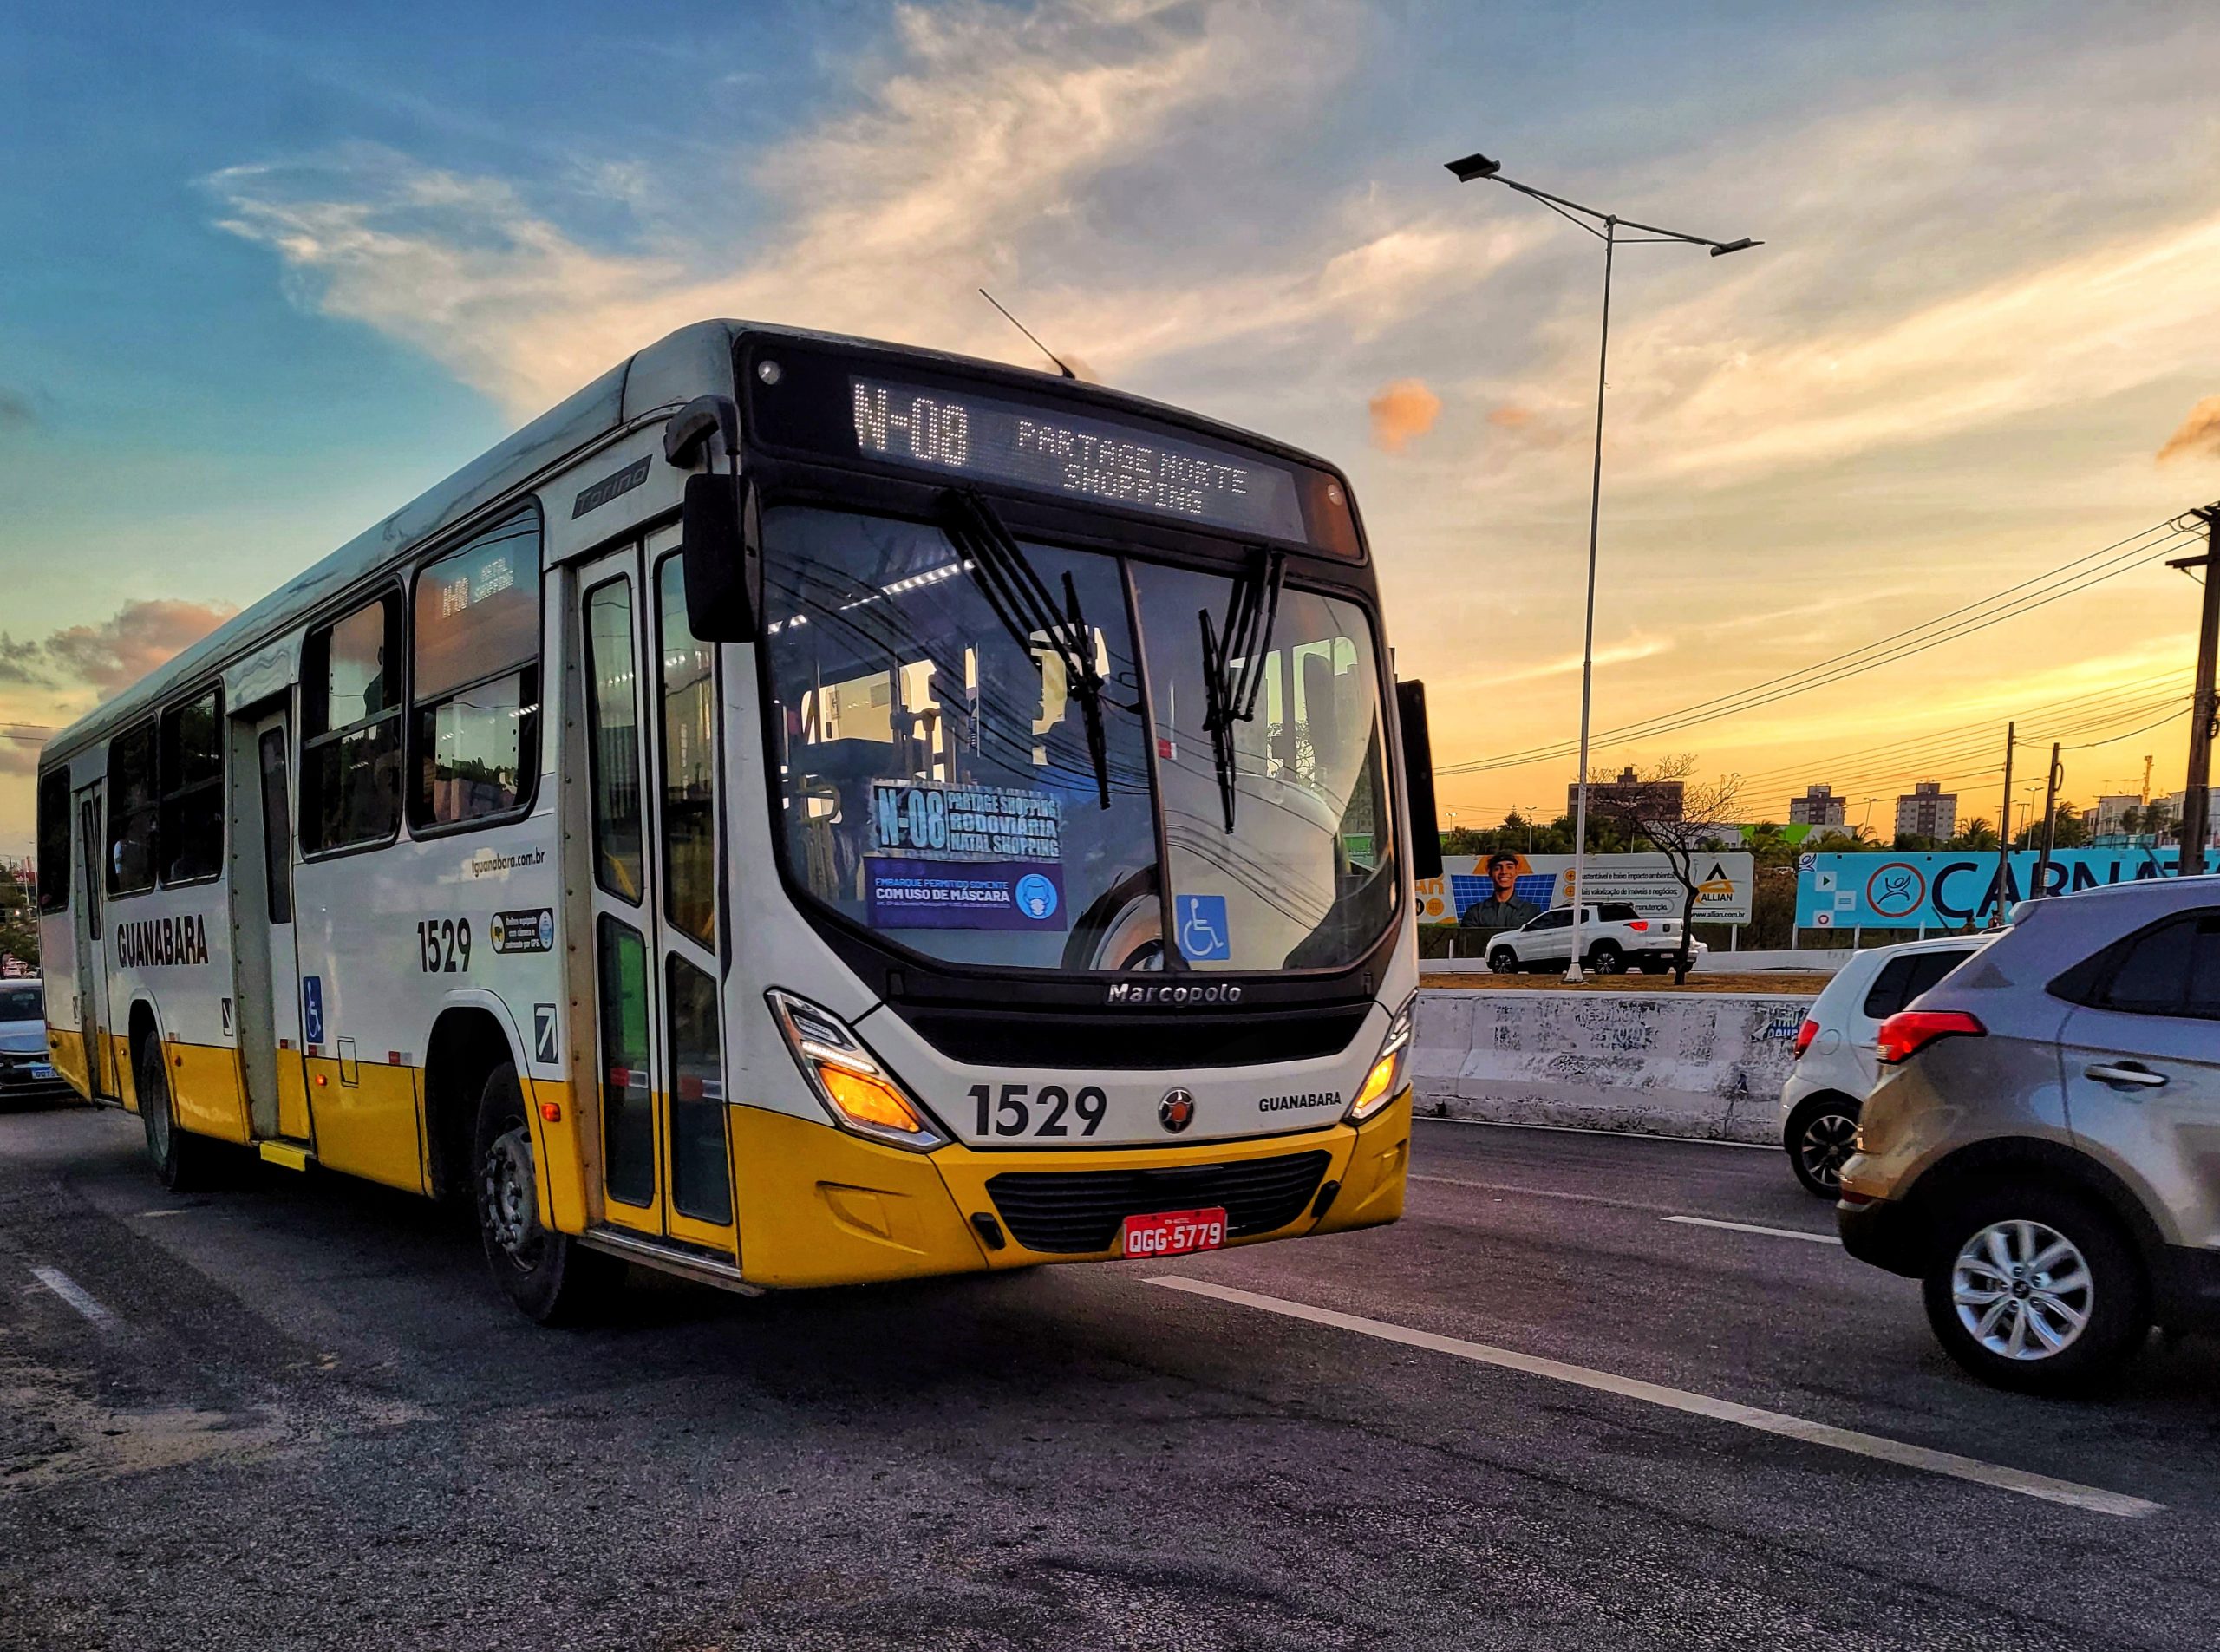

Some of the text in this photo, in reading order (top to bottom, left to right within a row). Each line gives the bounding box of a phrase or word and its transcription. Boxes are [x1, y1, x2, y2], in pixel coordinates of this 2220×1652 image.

[853, 383, 969, 467] N-08
[1018, 421, 1249, 494] PARTAGE NORTE
[1063, 463, 1203, 514] SHOPPING
[878, 787, 946, 849] N-08
[947, 791, 1057, 818] PARTAGE SHOPPING
[950, 813, 1057, 838] RODOVIÁRIA
[950, 833, 1061, 858] NATAL SHOPPING
[875, 887, 1010, 902] COM USO DE MÁSCARA
[1701, 893, 1733, 902] ALLIAN
[117, 914, 209, 968] GUANABARA
[417, 917, 472, 972] 1529
[1107, 983, 1243, 1005] Marcopolo
[967, 1084, 1107, 1137] 1529
[1258, 1091, 1342, 1113] GUANABARA
